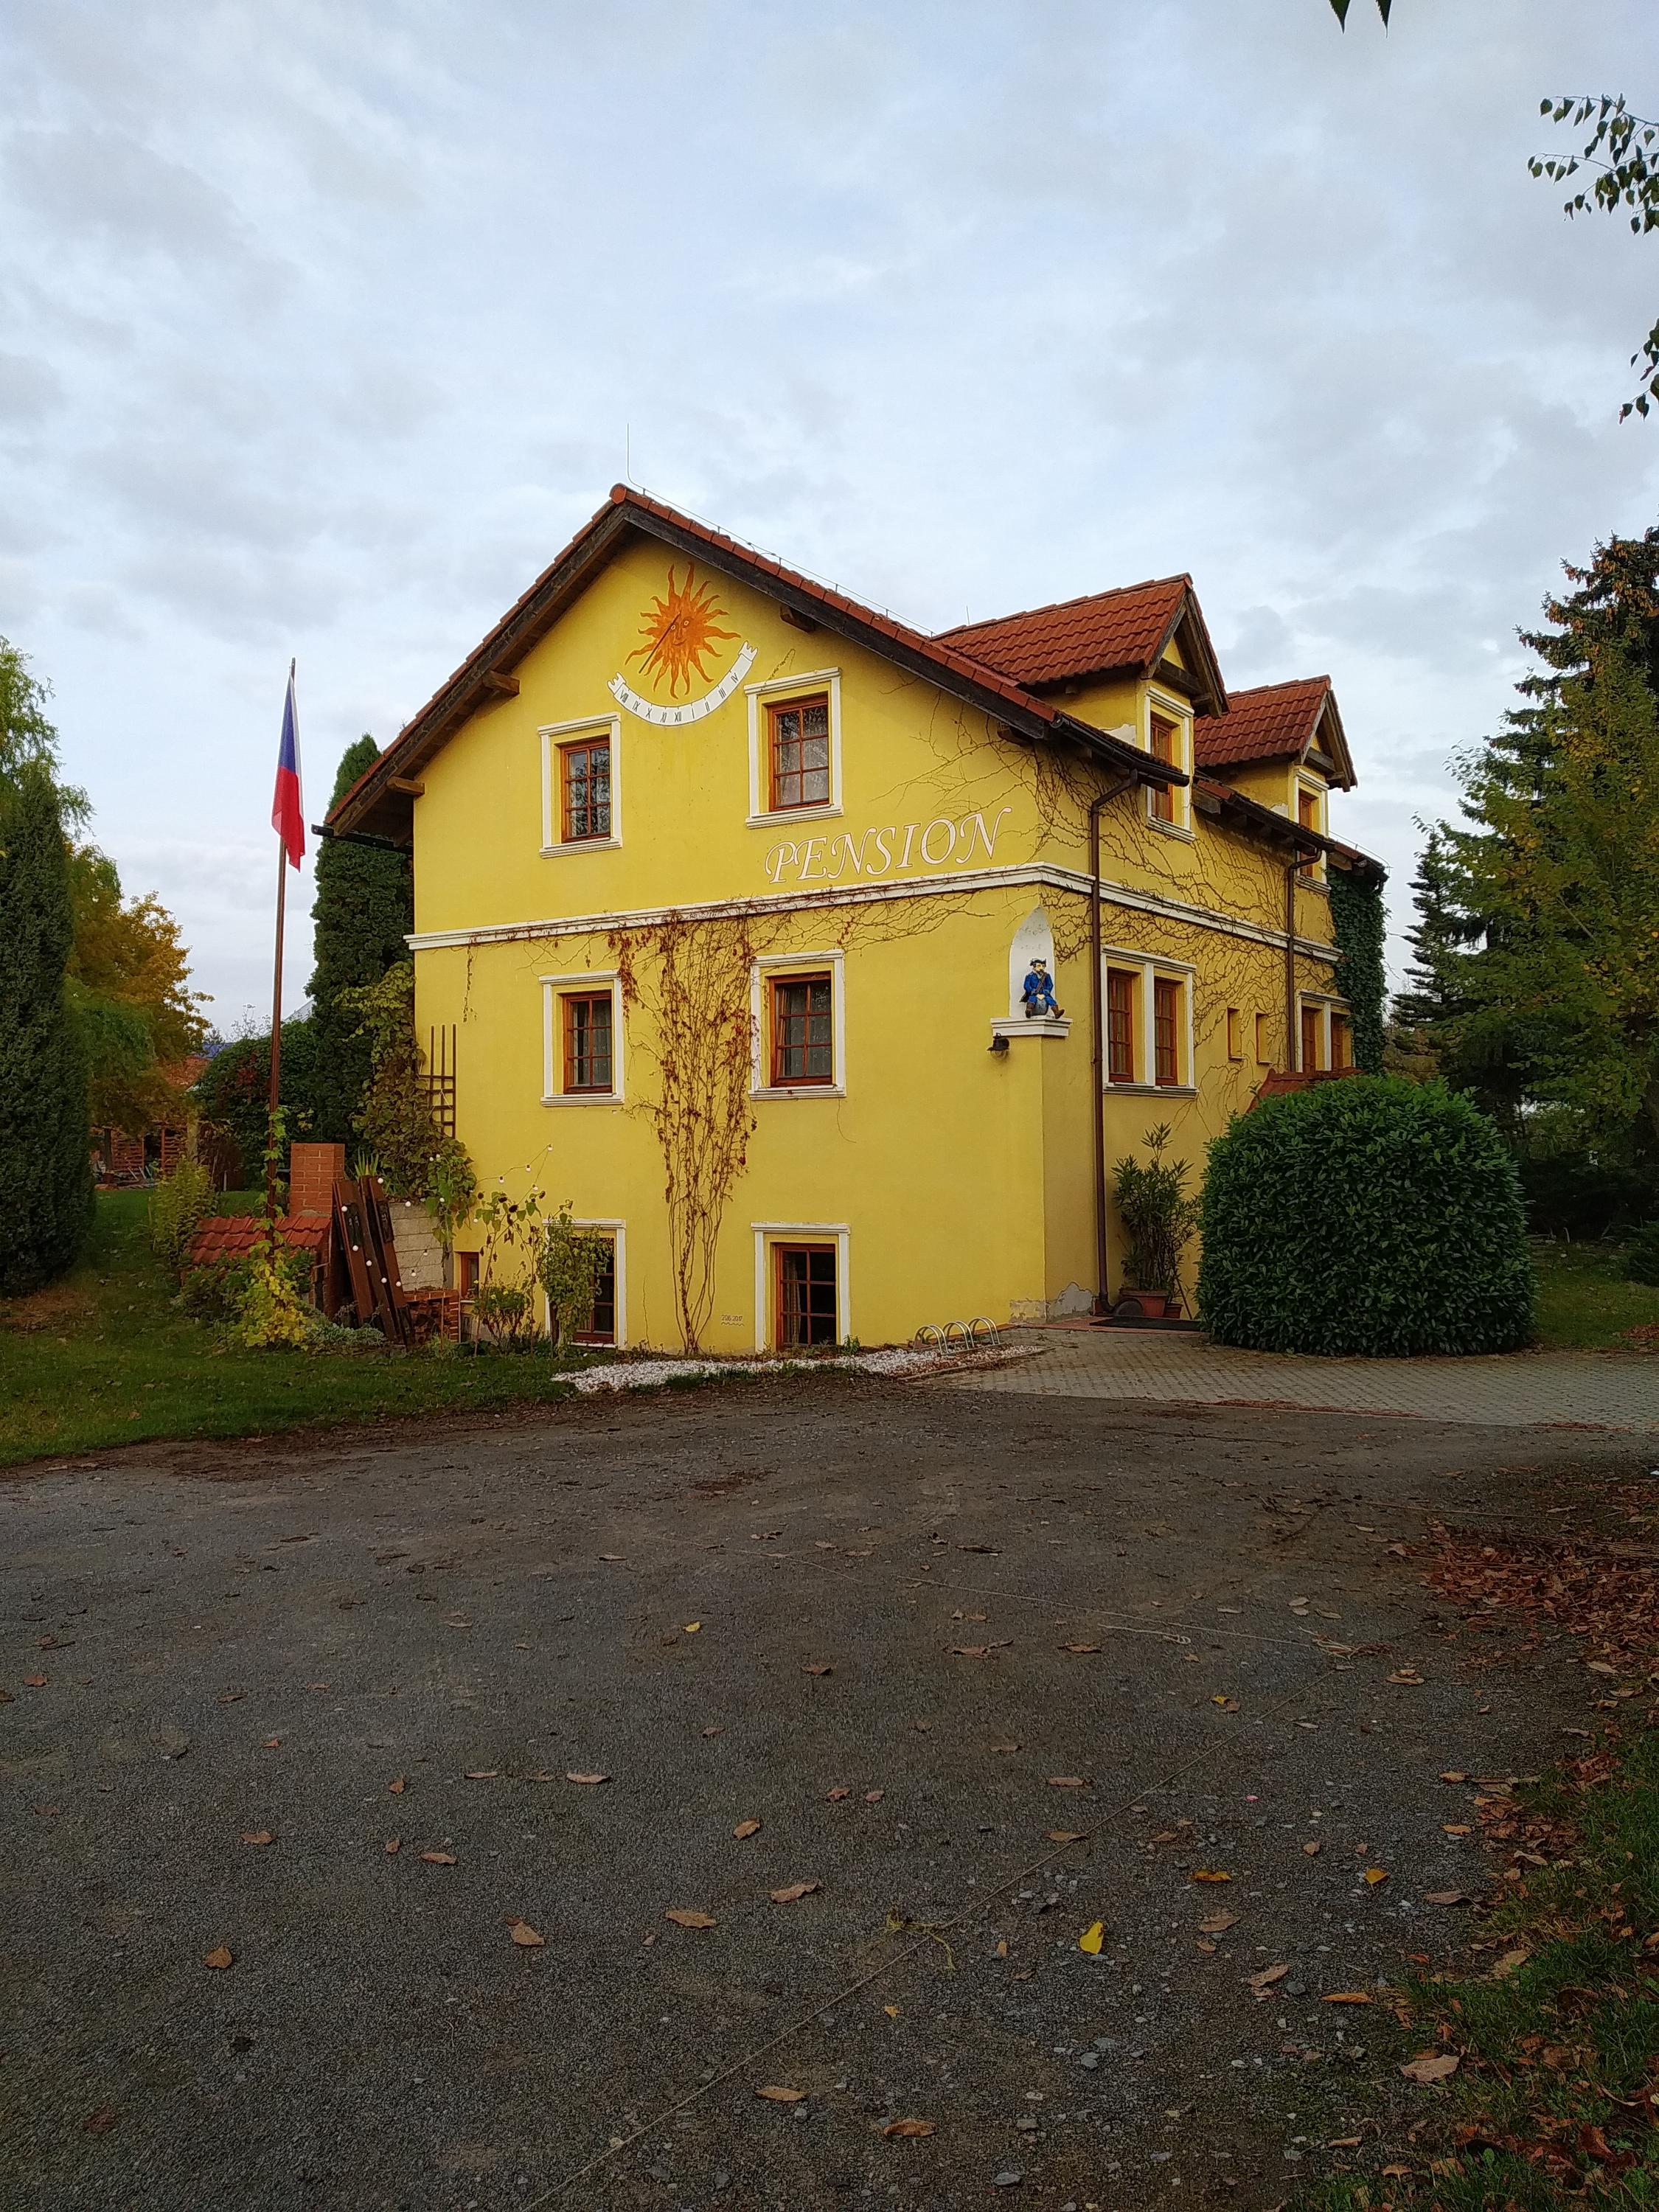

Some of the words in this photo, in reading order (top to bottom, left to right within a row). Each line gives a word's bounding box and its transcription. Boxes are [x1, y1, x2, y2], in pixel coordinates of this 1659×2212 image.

[632, 700, 641, 712] IX
[645, 707, 653, 719] X
[660, 712, 667, 723] XI
[674, 711, 682, 723] XII
[691, 708, 695, 719] I
[704, 701, 710, 712] II
[718, 687, 726, 699] III
[730, 672, 739, 684] IV
[764, 807, 1012, 884] PENSION
